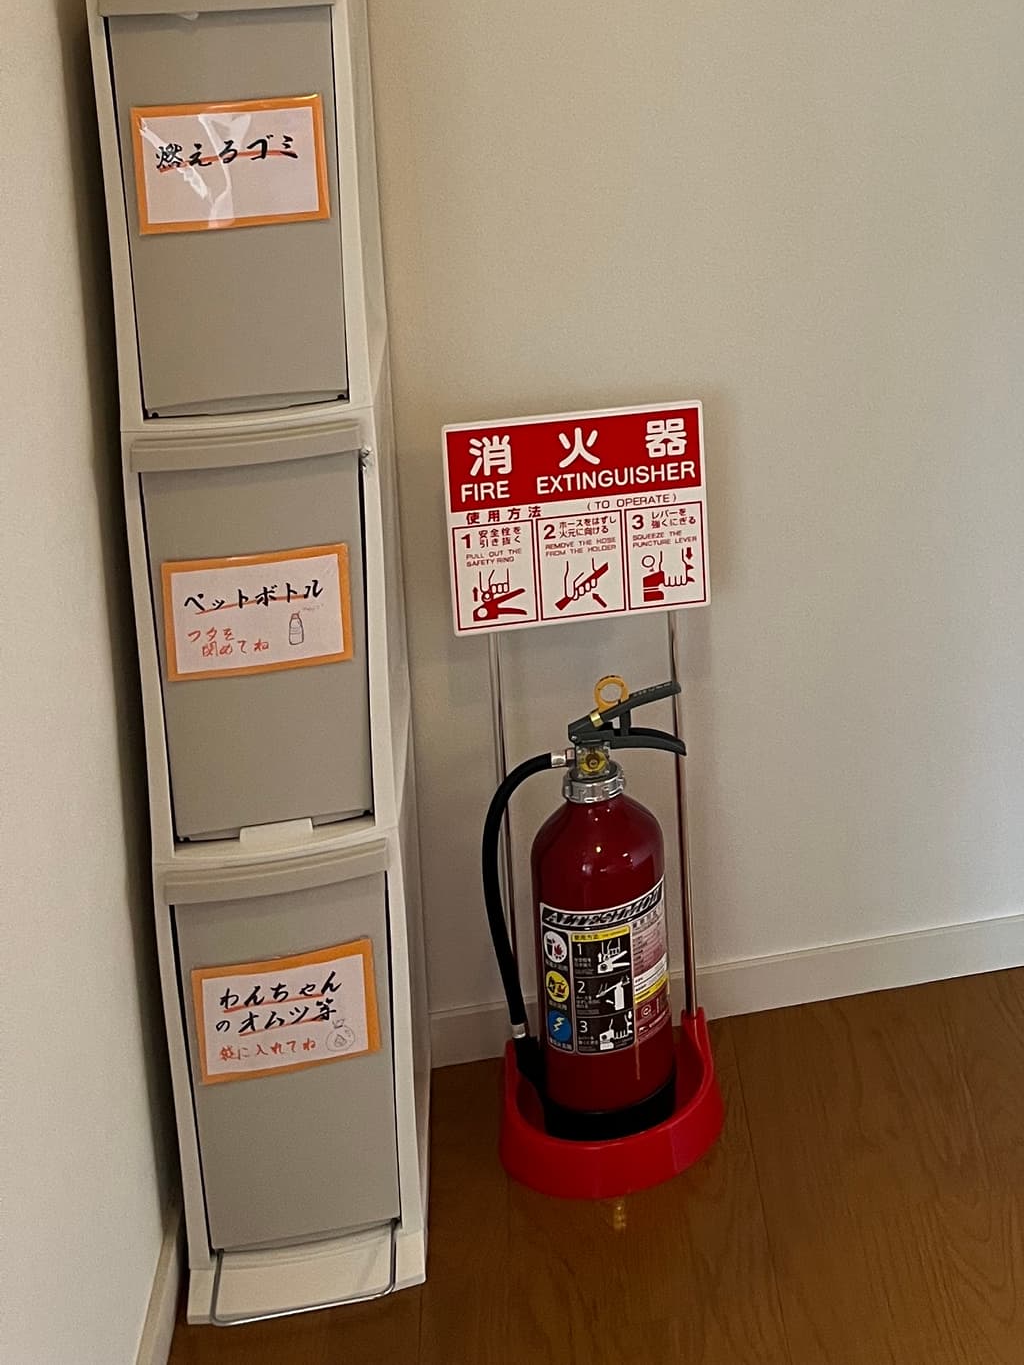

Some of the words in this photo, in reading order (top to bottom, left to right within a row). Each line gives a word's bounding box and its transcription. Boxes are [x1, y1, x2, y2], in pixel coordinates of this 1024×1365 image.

[155, 134, 299, 170] 燃えるゴミ
[469, 417, 688, 477] 消火器
[461, 480, 511, 503] FIRE
[536, 460, 696, 495] EXTINGUISHER
[466, 505, 543, 525] 使用方法
[652, 508, 687, 520] レバーを
[559, 515, 617, 528] ホースをはずし
[631, 514, 644, 530] 3
[651, 516, 696, 529] 強くにぎる
[478, 526, 521, 539] 安全栓を
[543, 524, 556, 540] 2
[559, 525, 609, 538] 火元に向ける
[632, 532, 665, 541] SQUEEZE
[461, 533, 472, 549] 1
[479, 535, 521, 548] 引き抜く
[545, 541, 574, 550] REMOVE
[578, 539, 593, 547] THE
[632, 538, 672, 548] PUNCTURE
[675, 536, 697, 544] LEVER
[488, 550, 504, 558] OUT
[545, 549, 566, 557] FROM
[587, 544, 616, 552] HOLDER
[466, 558, 496, 568] SAFETY
[183, 579, 324, 612] ペットボトル
[188, 626, 235, 643] フタを
[219, 970, 343, 1009] わんちゃん
[577, 981, 586, 993] 2
[215, 998, 338, 1033] のオムツ等
[578, 1020, 588, 1033] 3
